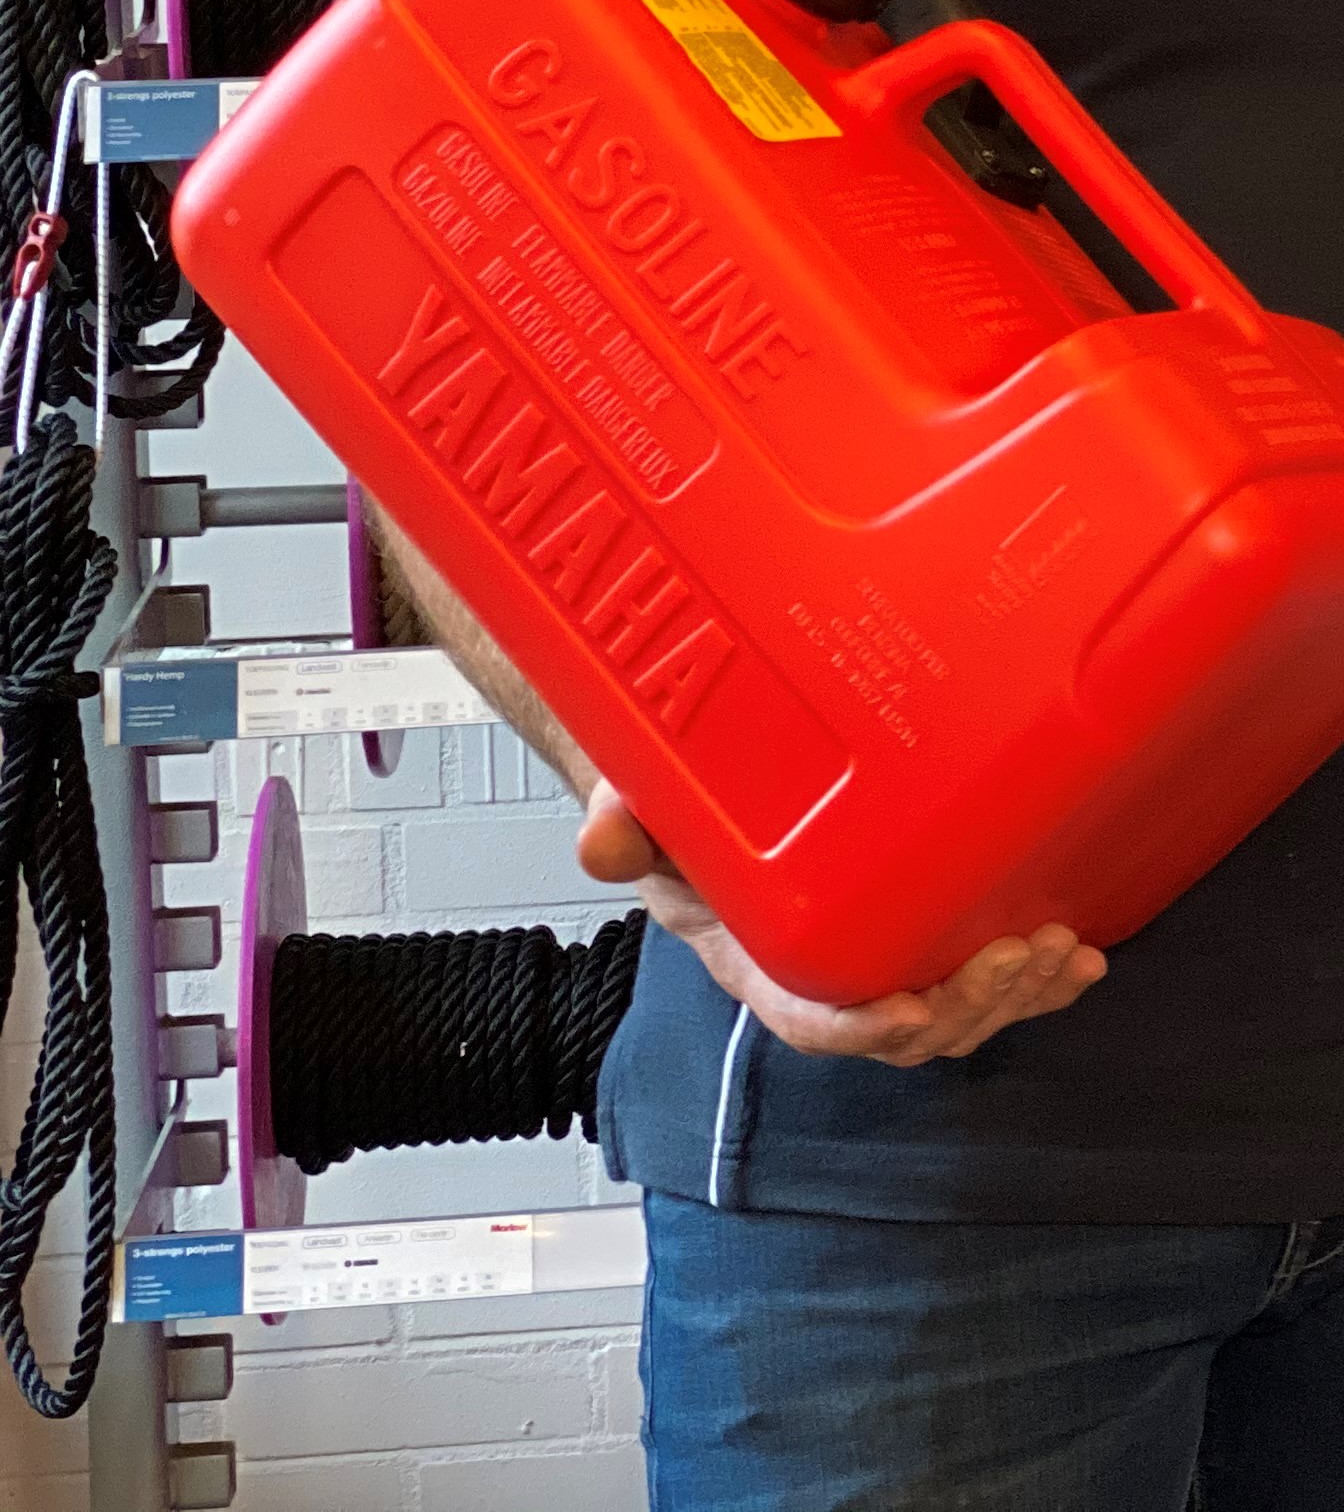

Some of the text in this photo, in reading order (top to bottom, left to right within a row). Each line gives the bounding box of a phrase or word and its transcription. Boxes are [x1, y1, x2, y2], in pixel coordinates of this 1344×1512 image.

[430, 128, 678, 413] GASOLINE FLAMMABLE DANGER
[488, 38, 809, 402] GASOLINE
[473, 254, 595, 386] INFLAMMABLE
[573, 372, 682, 490] DANGEREUX
[376, 283, 736, 732] YAMAHA
[156, 670, 186, 681] Hemp
[185, 1243, 236, 1256] polyester
